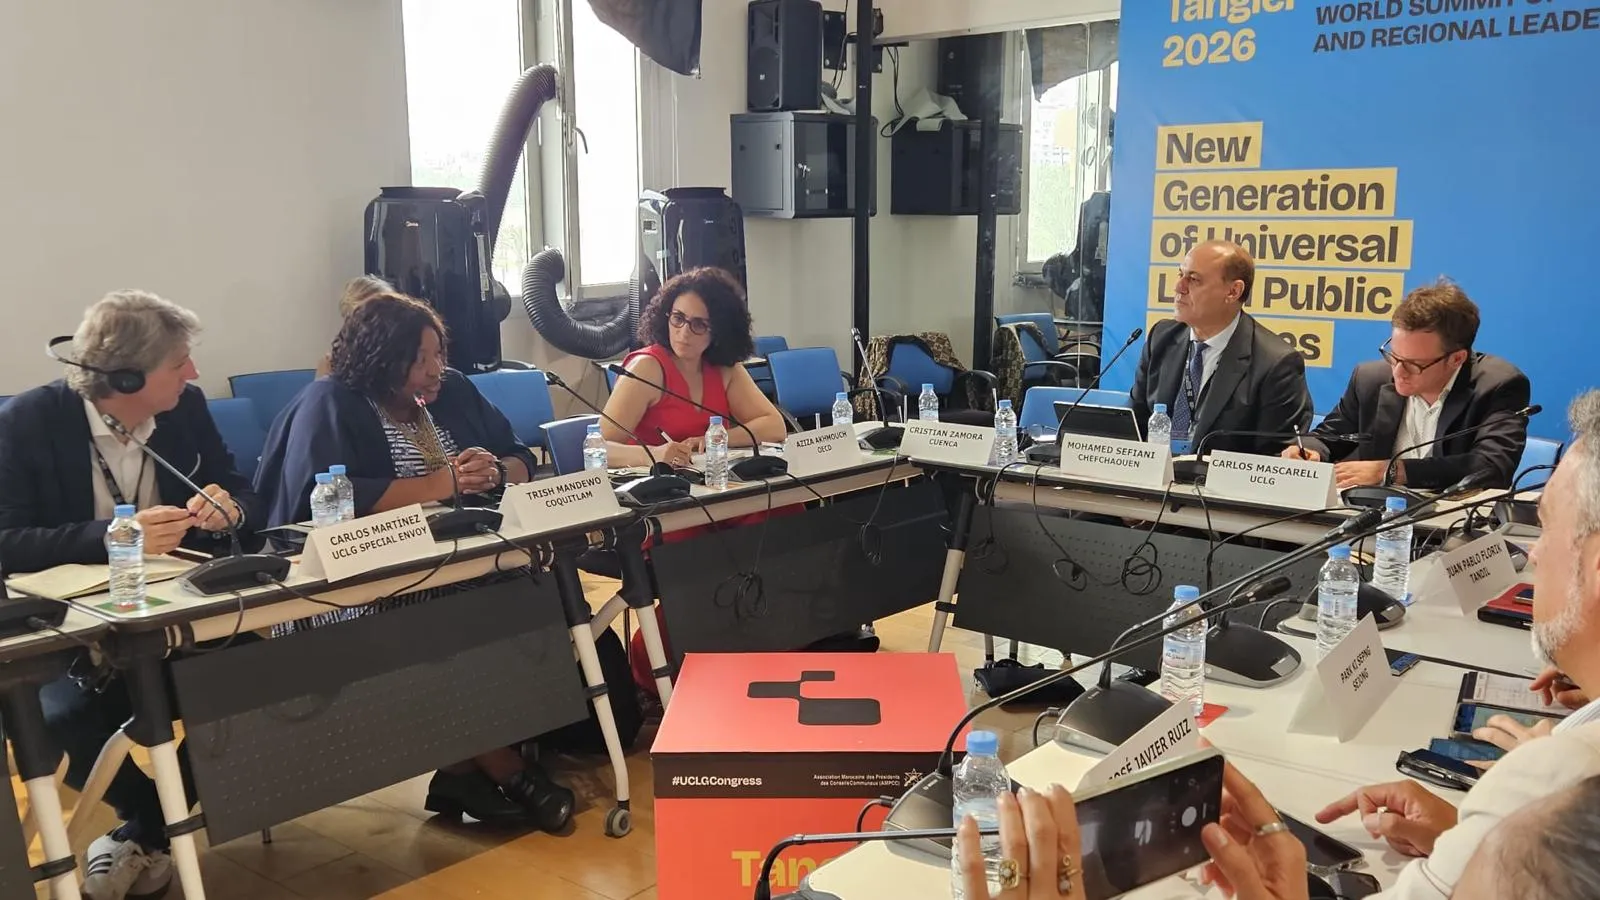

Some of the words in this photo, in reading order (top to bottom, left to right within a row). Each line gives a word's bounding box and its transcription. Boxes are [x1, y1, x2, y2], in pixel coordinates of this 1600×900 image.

[1316, 0, 1402, 25] WORLD
[1313, 31, 1365, 52] AND
[1371, 18, 1502, 48] REGIONAL
[1508, 8, 1600, 36] LEADE
[1163, 28, 1256, 67] 2026
[1166, 132, 1252, 164] New
[1163, 174, 1385, 211] Generation
[1160, 225, 1199, 258] of
[1263, 276, 1393, 315] Public
[796, 438, 814, 448] AZIZA
[815, 431, 847, 443] AKHMOUCH
[909, 426, 948, 437] CRISTIAN
[949, 430, 983, 440] ZAMORA
[929, 438, 958, 447] CUENCA
[817, 444, 832, 453] OECD
[1067, 441, 1113, 454] MOHAMED
[1116, 447, 1155, 459] SEFIANI
[1078, 453, 1140, 468] CHEFCHAOUEN
[1212, 459, 1253, 471] CARLOS
[1256, 464, 1319, 479] MASCARELL
[526, 487, 555, 500] TRISH
[556, 476, 602, 493] MANDEWO
[1249, 475, 1276, 485] UCLG
[545, 491, 593, 507] COQUITLAM
[330, 528, 370, 545] CARLOS
[332, 545, 358, 560] UCLG
[359, 535, 398, 552] SPECIAL
[398, 526, 427, 541] ENVOY
[1462, 553, 1481, 570] PABLO
[1134, 736, 1169, 770] JAVIER
[1167, 718, 1191, 746] RUIZ
[672, 776, 762, 788] #UCLGCongress
[731, 851, 838, 888] Tan
